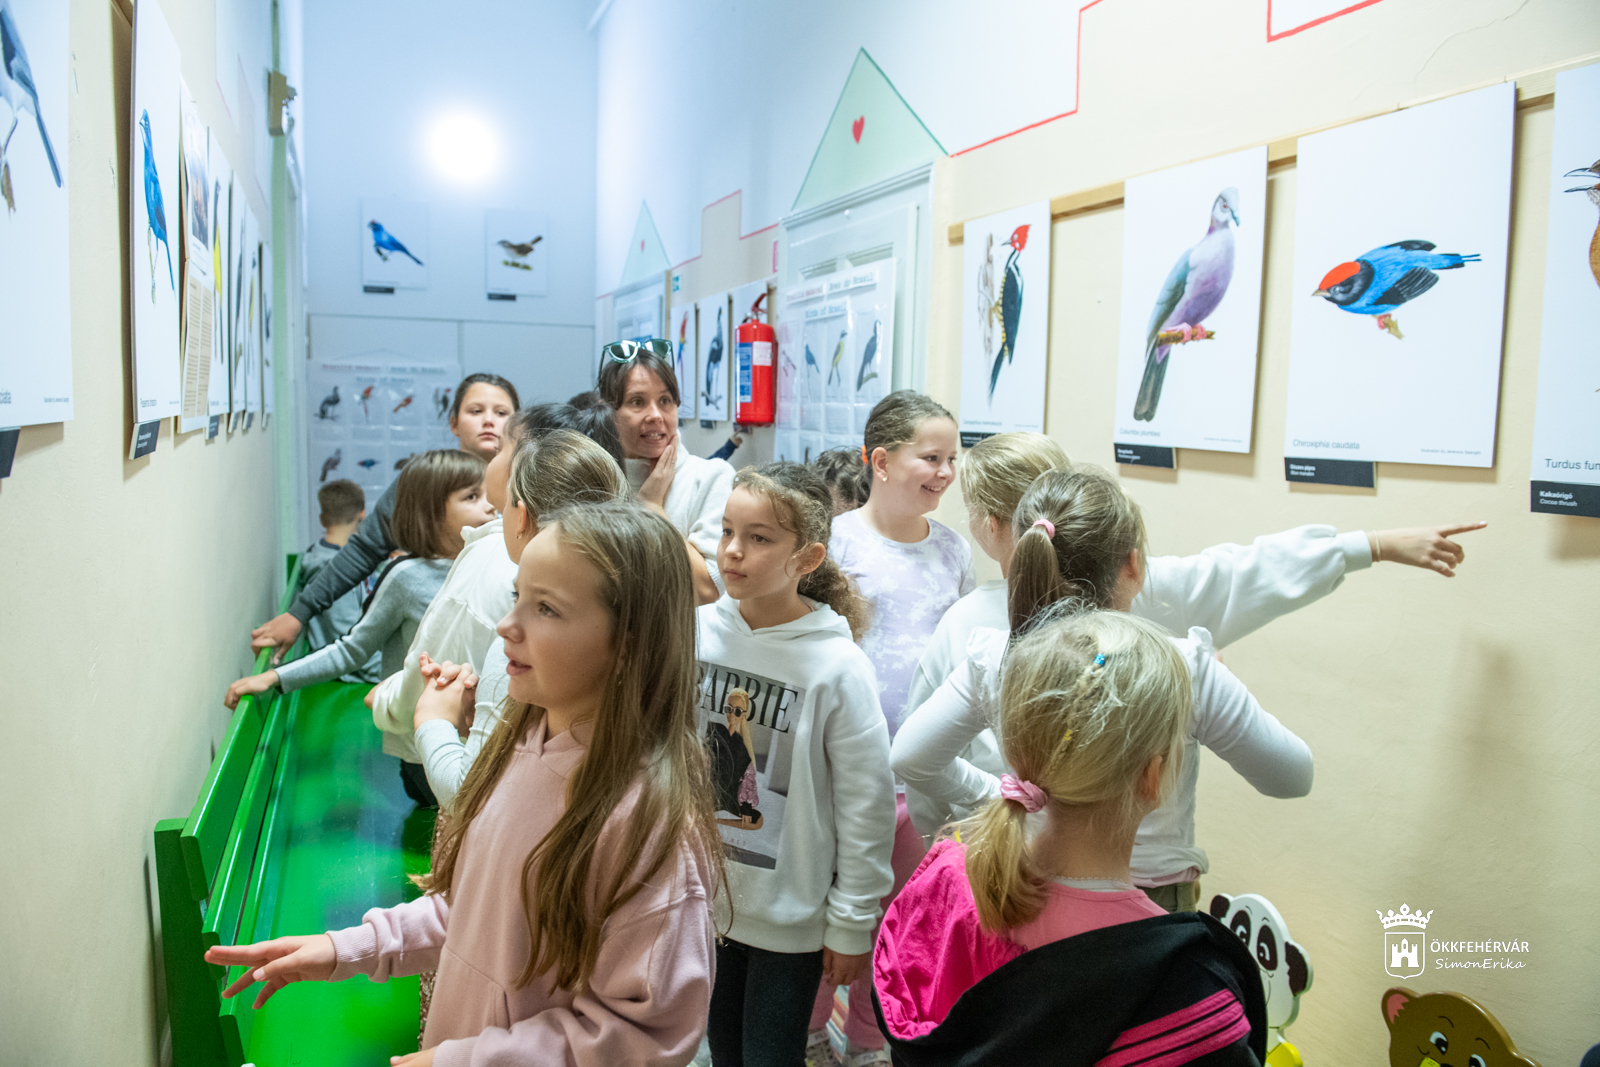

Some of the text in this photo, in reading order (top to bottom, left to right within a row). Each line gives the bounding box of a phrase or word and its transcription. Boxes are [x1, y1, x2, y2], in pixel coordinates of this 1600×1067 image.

[1293, 438, 1360, 450] Chiroxiphia caudata
[1544, 458, 1582, 470] Turdus
[1539, 490, 1574, 500] Kakaórigó
[1539, 498, 1558, 506] Cocoa
